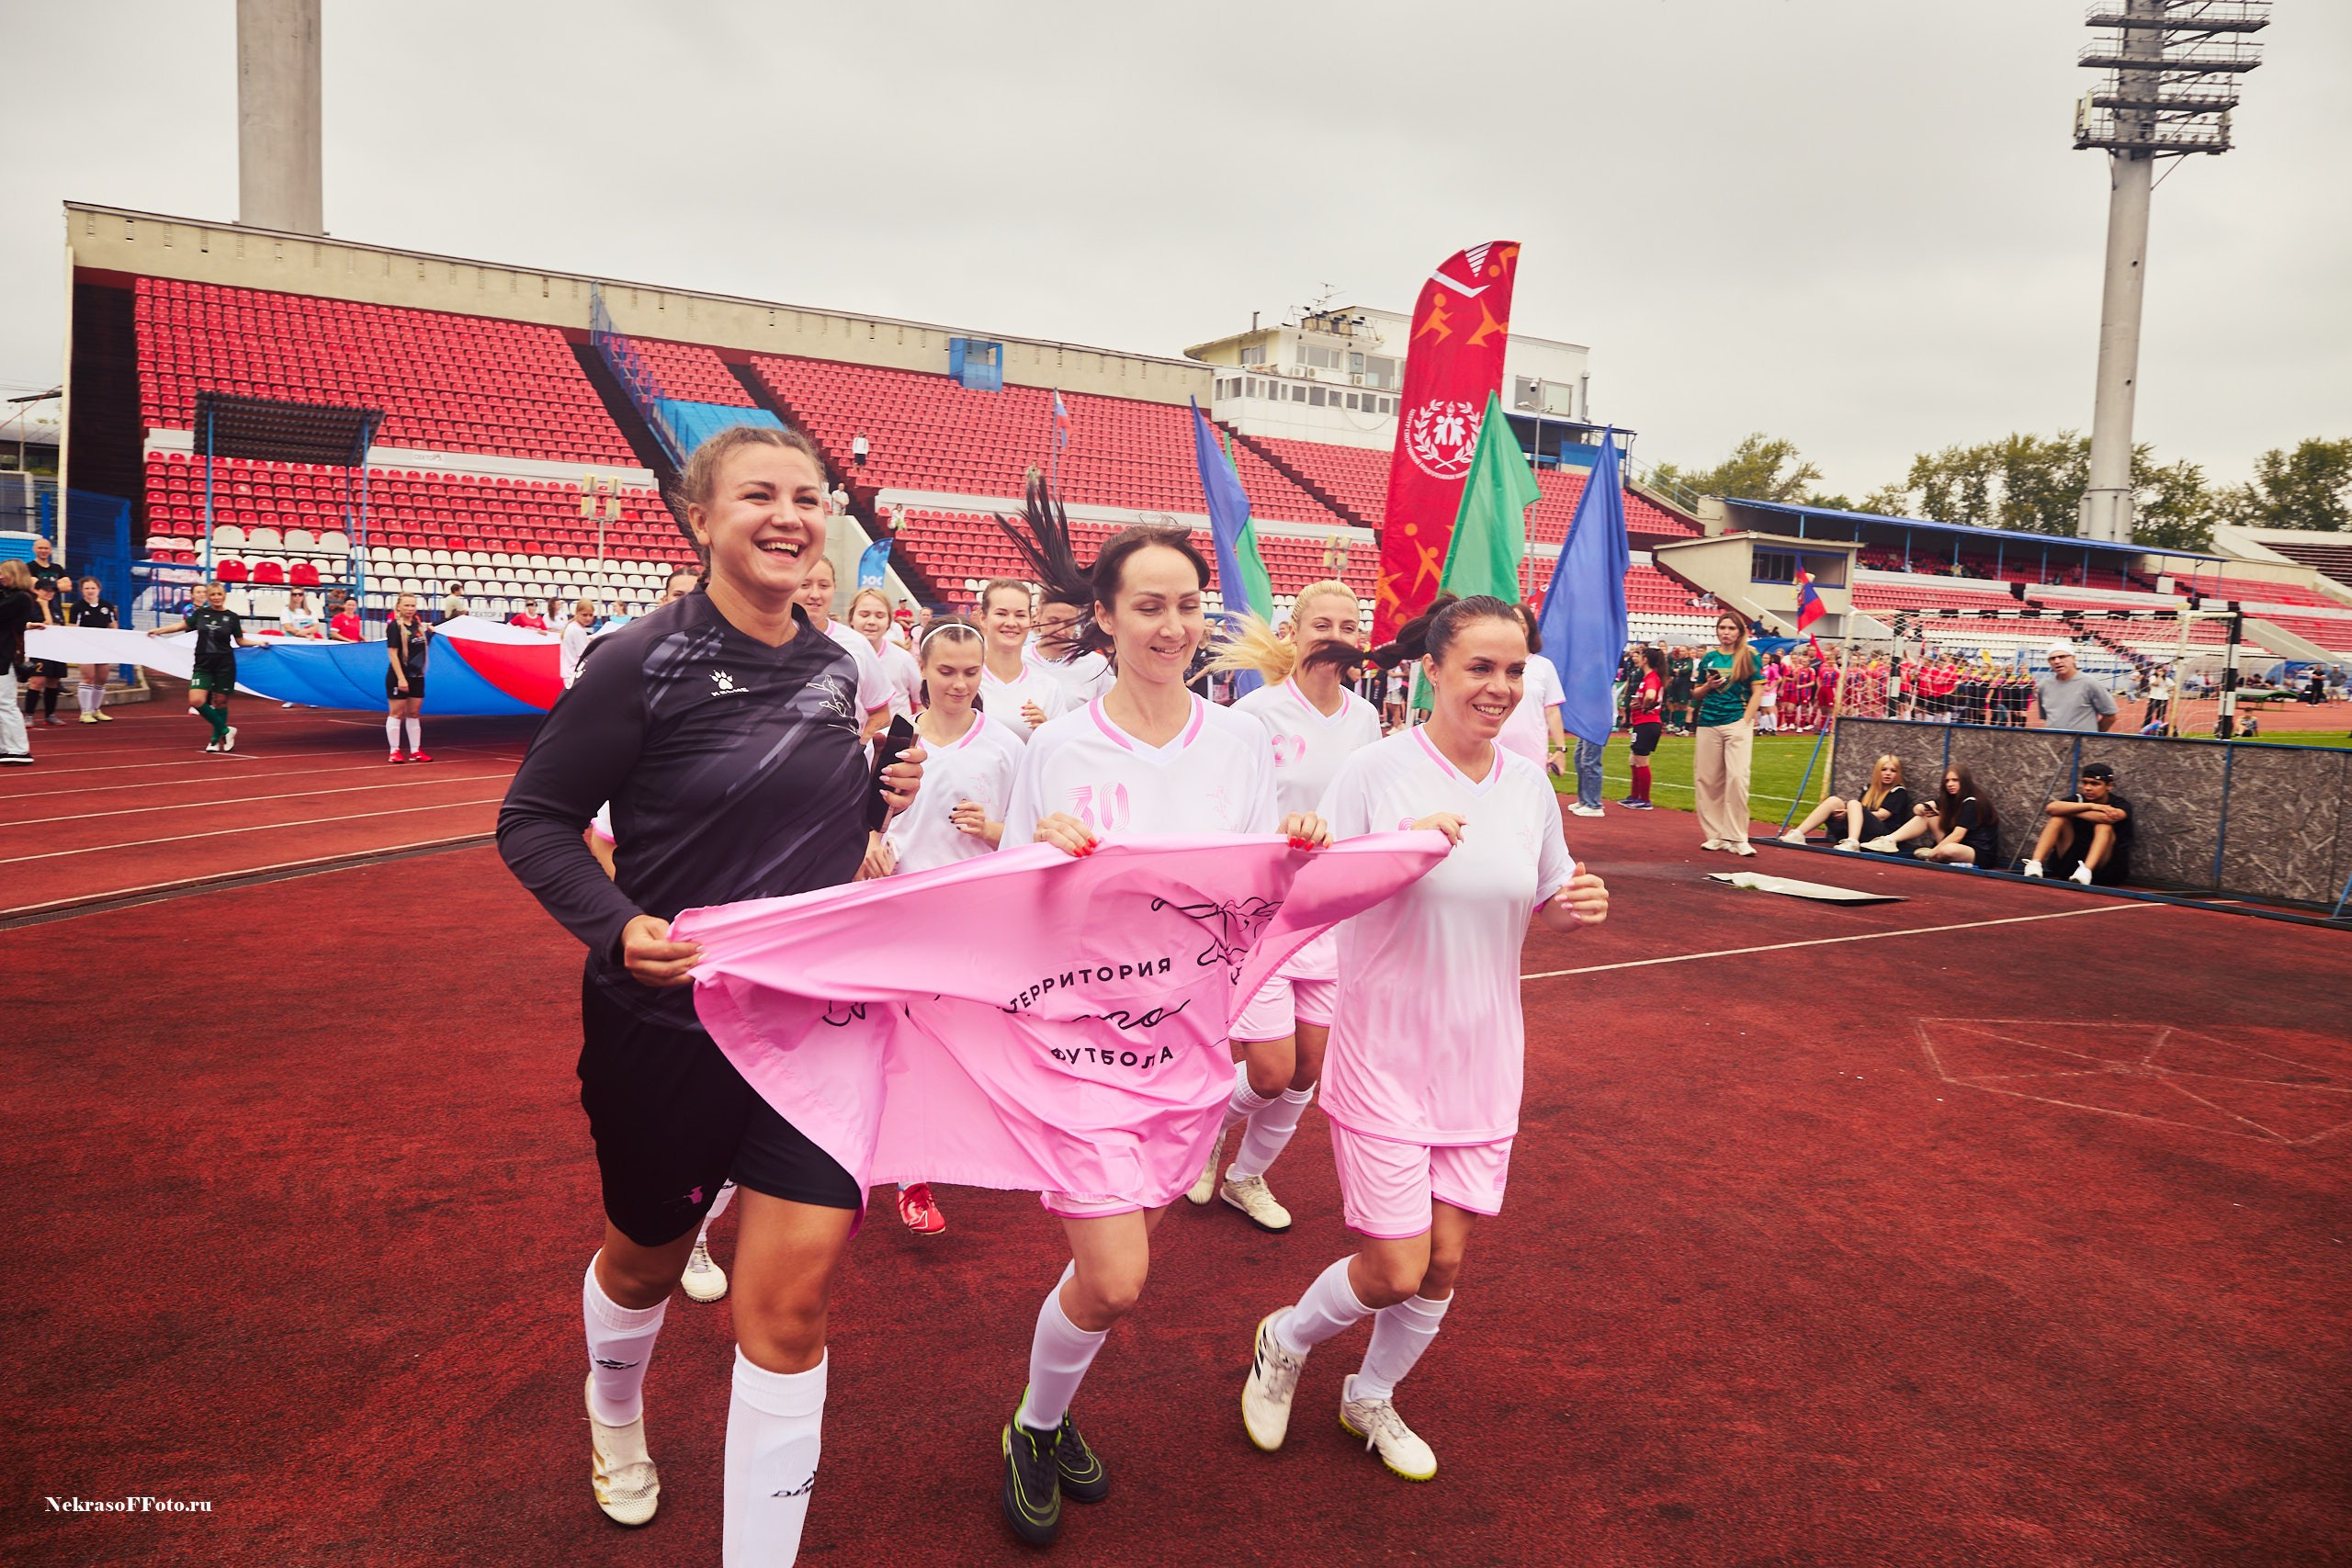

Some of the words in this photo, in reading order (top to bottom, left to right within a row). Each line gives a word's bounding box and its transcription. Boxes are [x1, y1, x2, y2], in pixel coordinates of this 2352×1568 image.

[1066, 782, 1130, 832] 30
[1009, 957, 1170, 1013] ТЕРРИТОРИЯ
[1050, 1045, 1173, 1069] ФУТБОЛА
